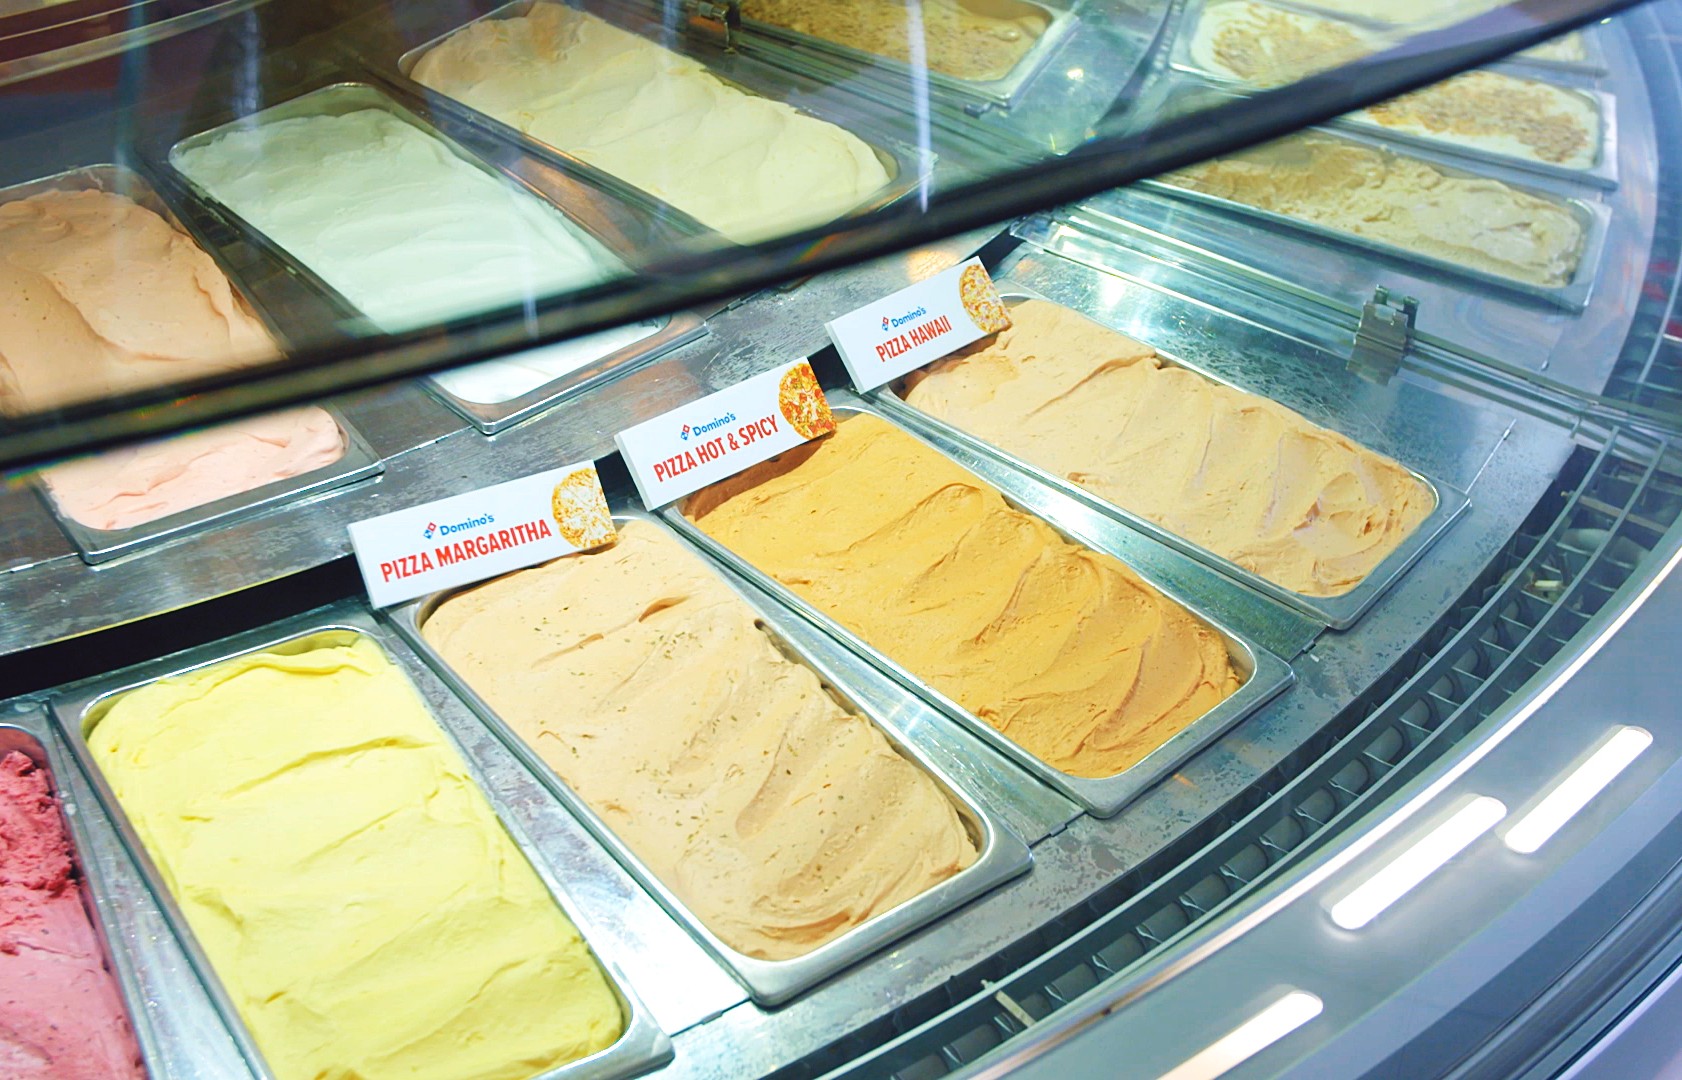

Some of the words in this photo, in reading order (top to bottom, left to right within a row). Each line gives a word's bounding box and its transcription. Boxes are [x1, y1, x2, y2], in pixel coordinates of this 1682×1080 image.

[891, 306, 927, 328] Domino's
[875, 334, 912, 363] PIZZA
[908, 315, 953, 347] HAWAII
[692, 412, 736, 437] Domino's
[653, 451, 698, 482] PIZZA
[695, 437, 727, 464] HOT
[729, 433, 740, 451] &
[738, 414, 780, 446] SPICY
[439, 513, 495, 537] Domino's
[380, 552, 434, 583] PIZZA
[435, 519, 552, 568] MARGARITHA
